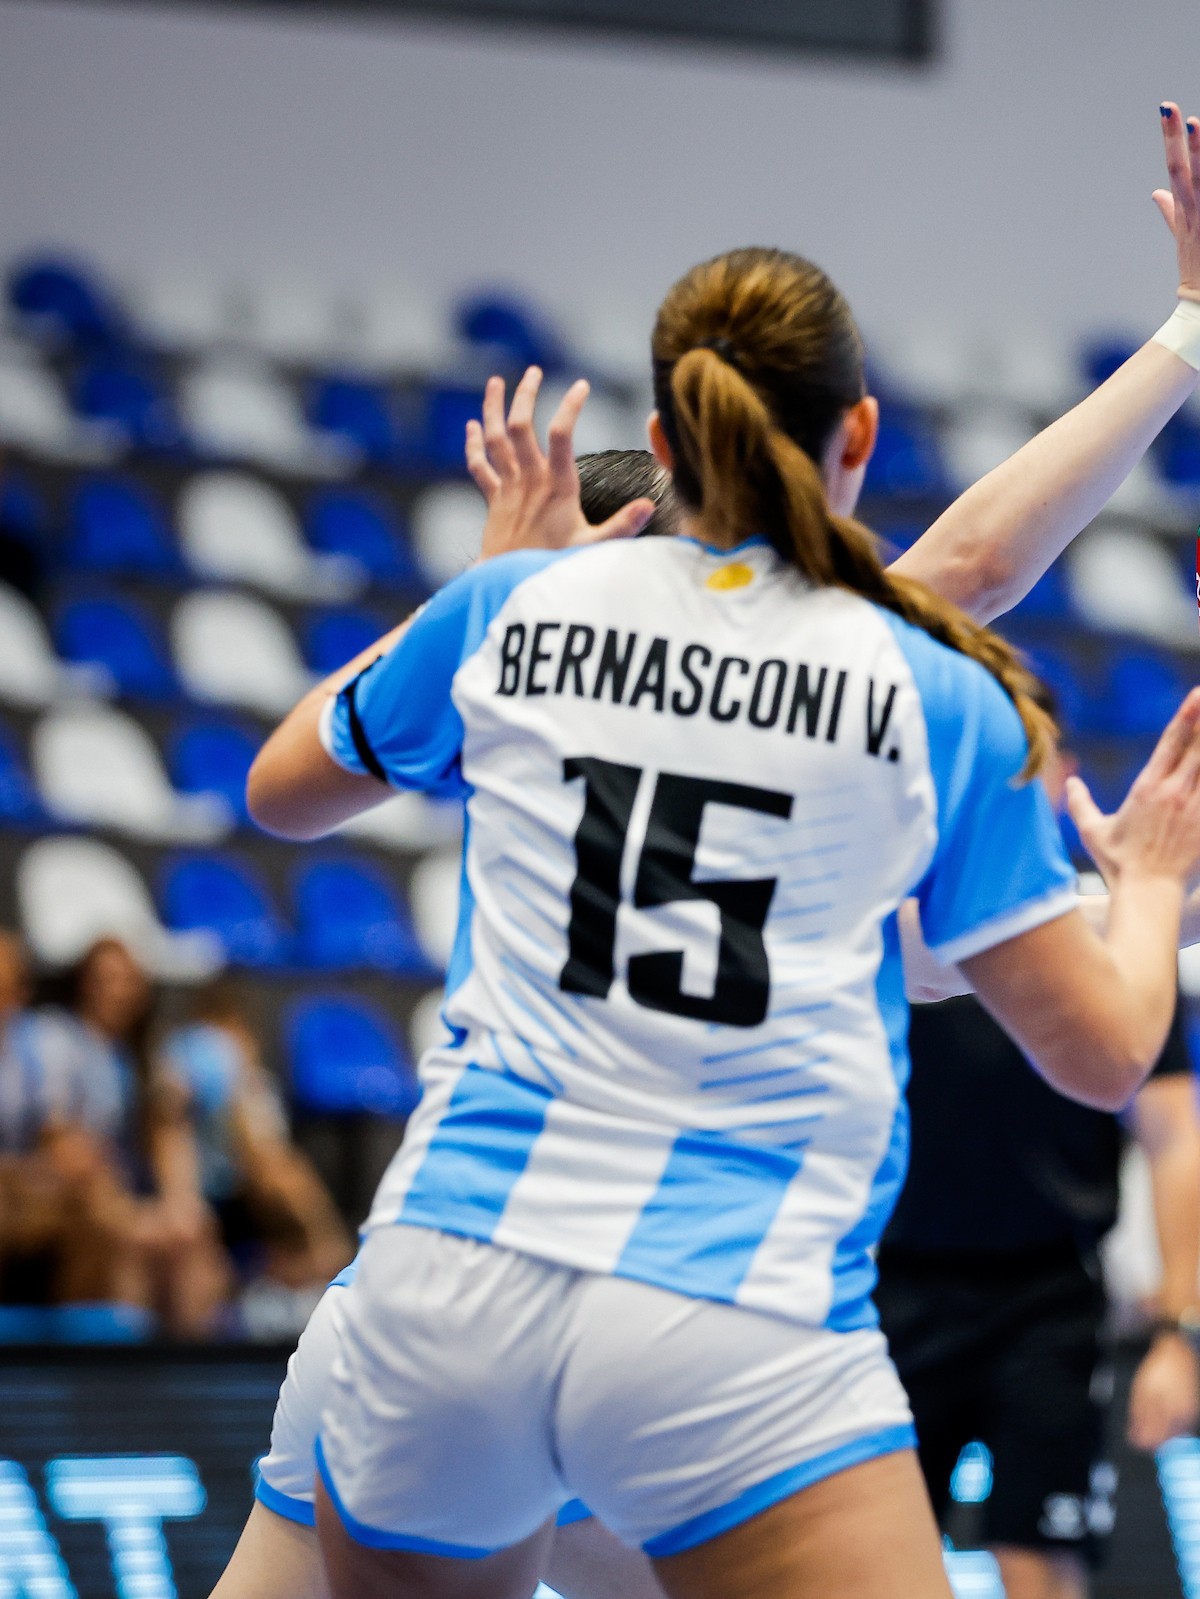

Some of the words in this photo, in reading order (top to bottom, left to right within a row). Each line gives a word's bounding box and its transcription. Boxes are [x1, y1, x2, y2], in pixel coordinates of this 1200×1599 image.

[497, 622, 848, 744] BERNASCONI
[866, 677, 902, 764] V.
[559, 755, 794, 1028] 15
